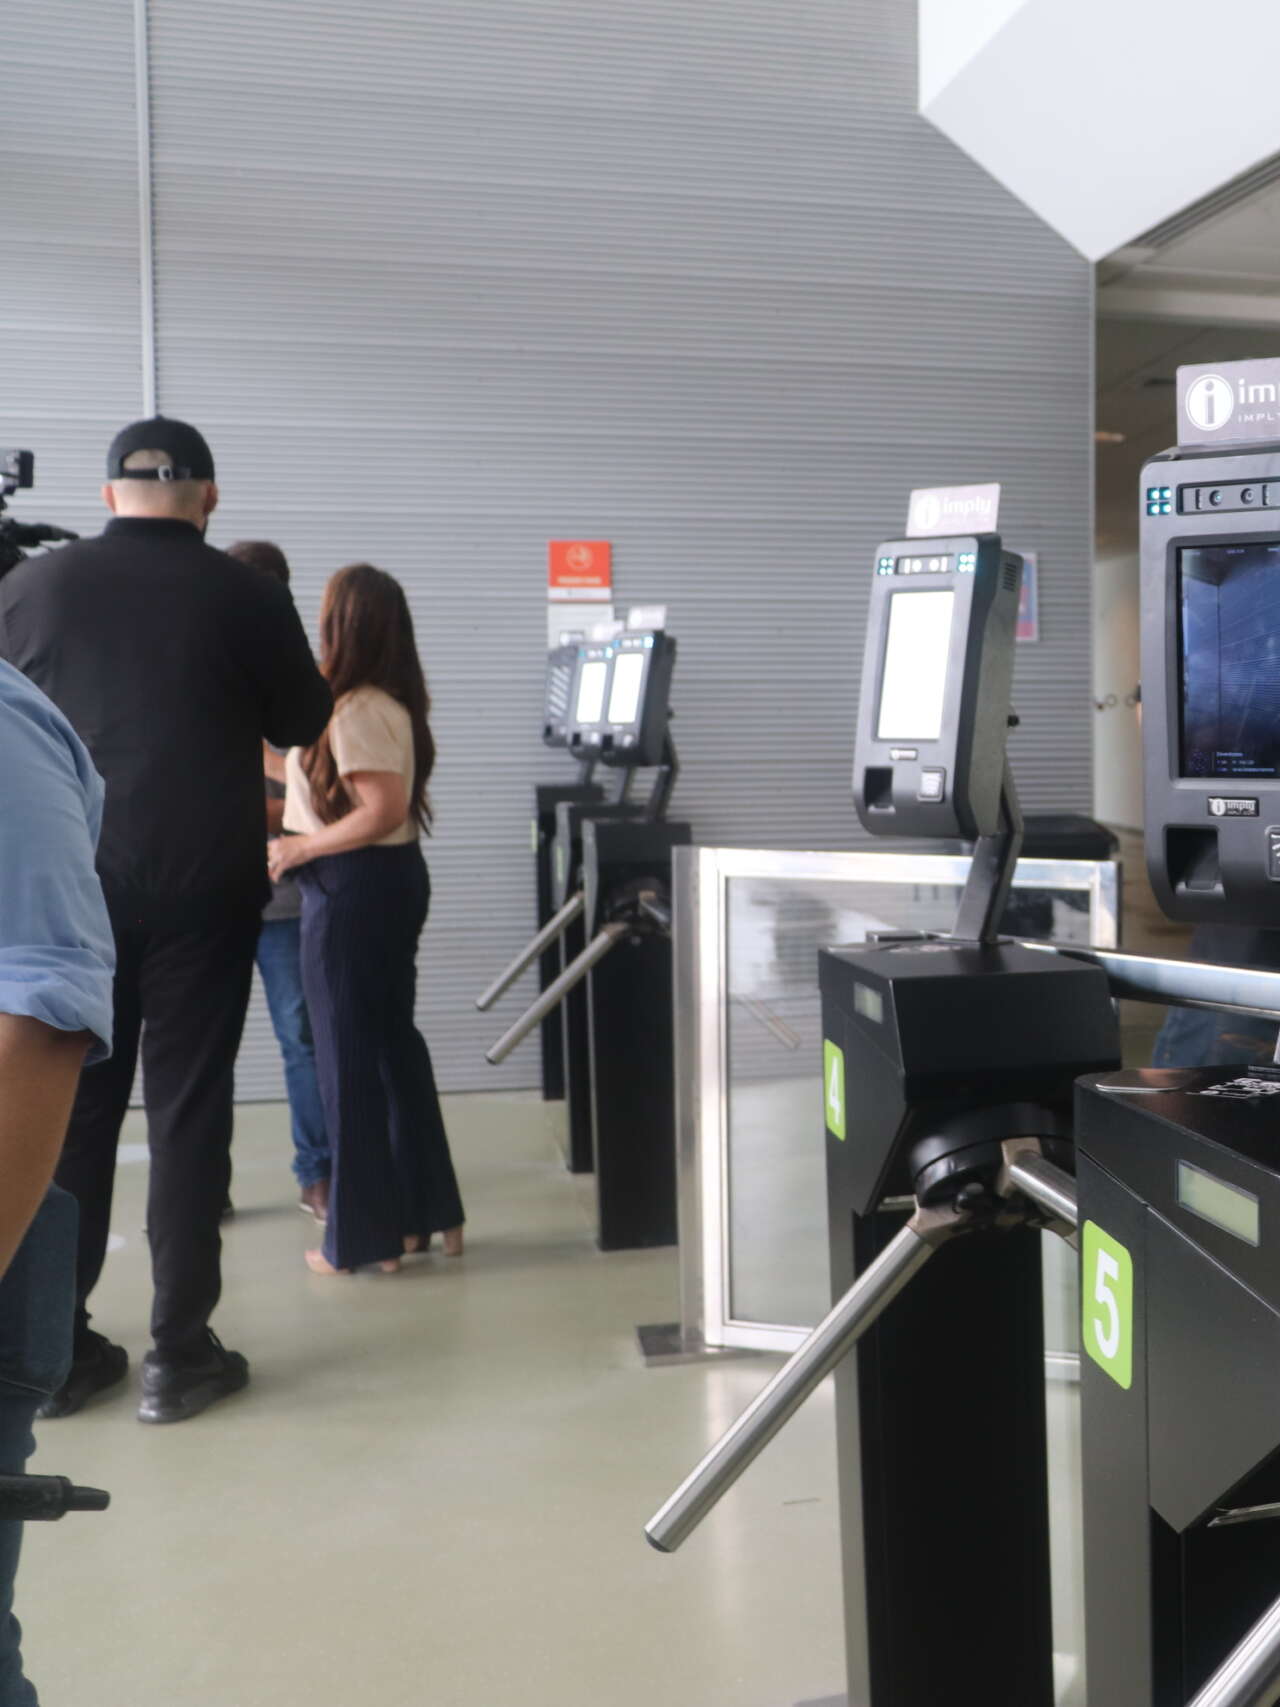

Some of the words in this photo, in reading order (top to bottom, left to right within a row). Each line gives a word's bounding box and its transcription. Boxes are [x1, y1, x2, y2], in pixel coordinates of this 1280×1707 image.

[942, 495, 992, 516] imply
[828, 1055, 841, 1125] 4
[1093, 1247, 1120, 1360] 5
